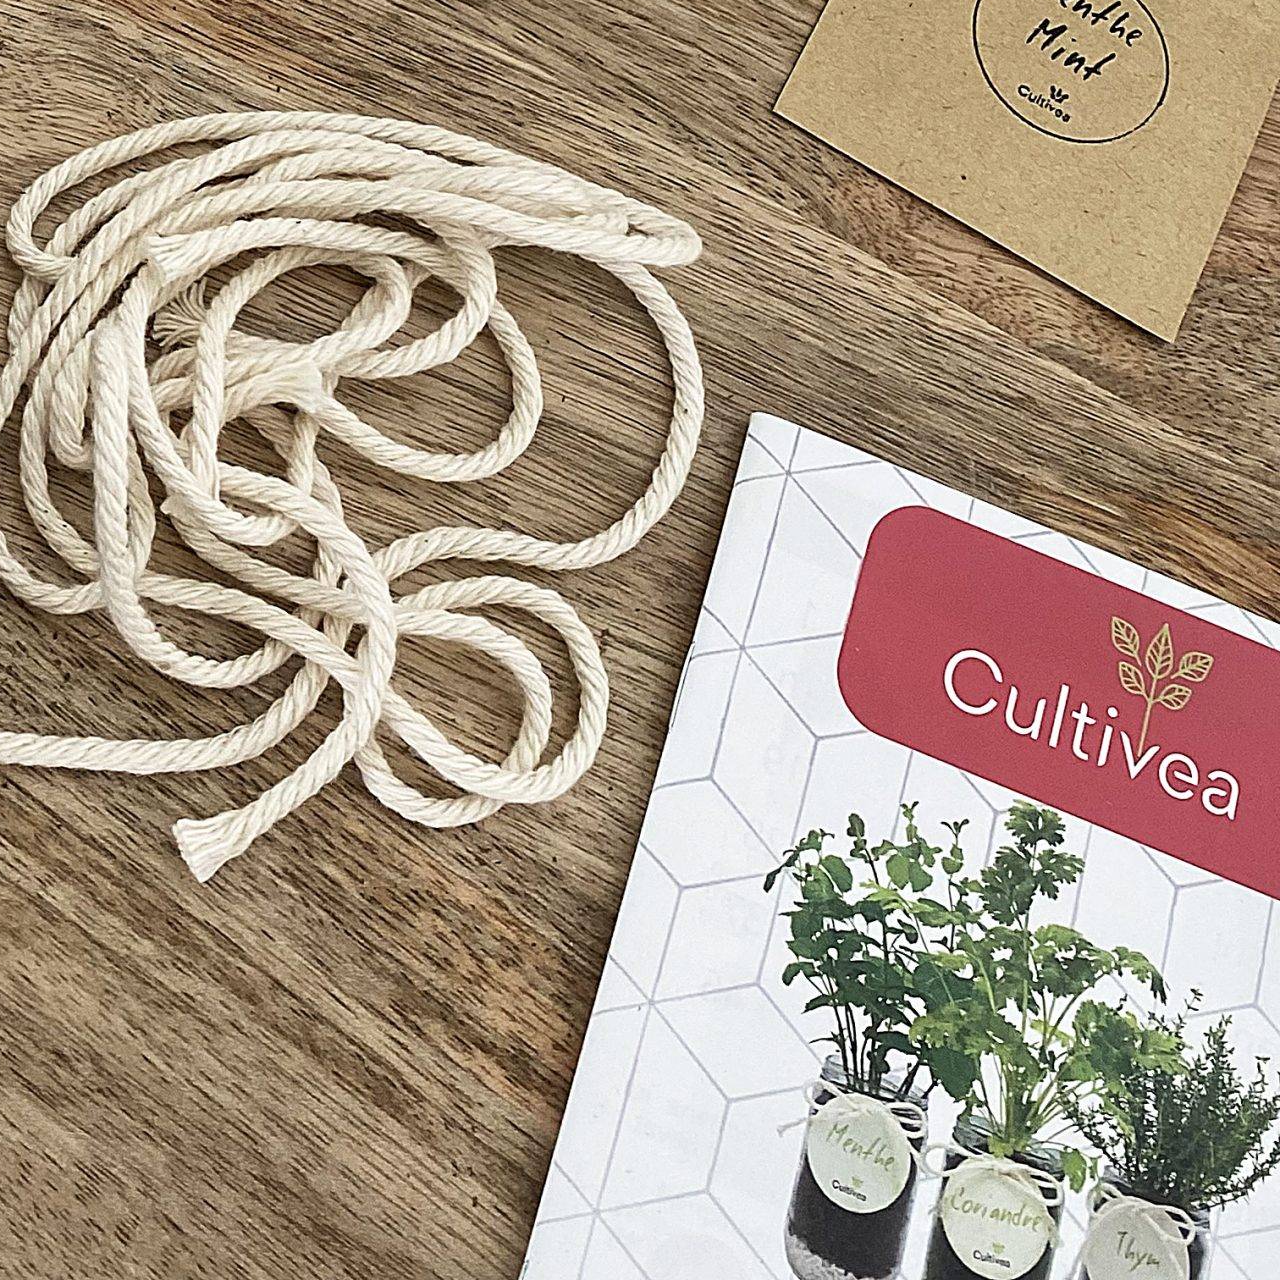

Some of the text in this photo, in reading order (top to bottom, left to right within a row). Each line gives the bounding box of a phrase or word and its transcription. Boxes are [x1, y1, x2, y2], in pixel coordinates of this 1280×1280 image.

[1026, 18, 1116, 81] Mint
[1018, 84, 1070, 123] Cultivea
[942, 648, 1241, 821] Cultivea
[826, 1121, 896, 1172] Menthe
[950, 1186, 1042, 1232] Coriandre
[1117, 1231, 1160, 1271] Thym
